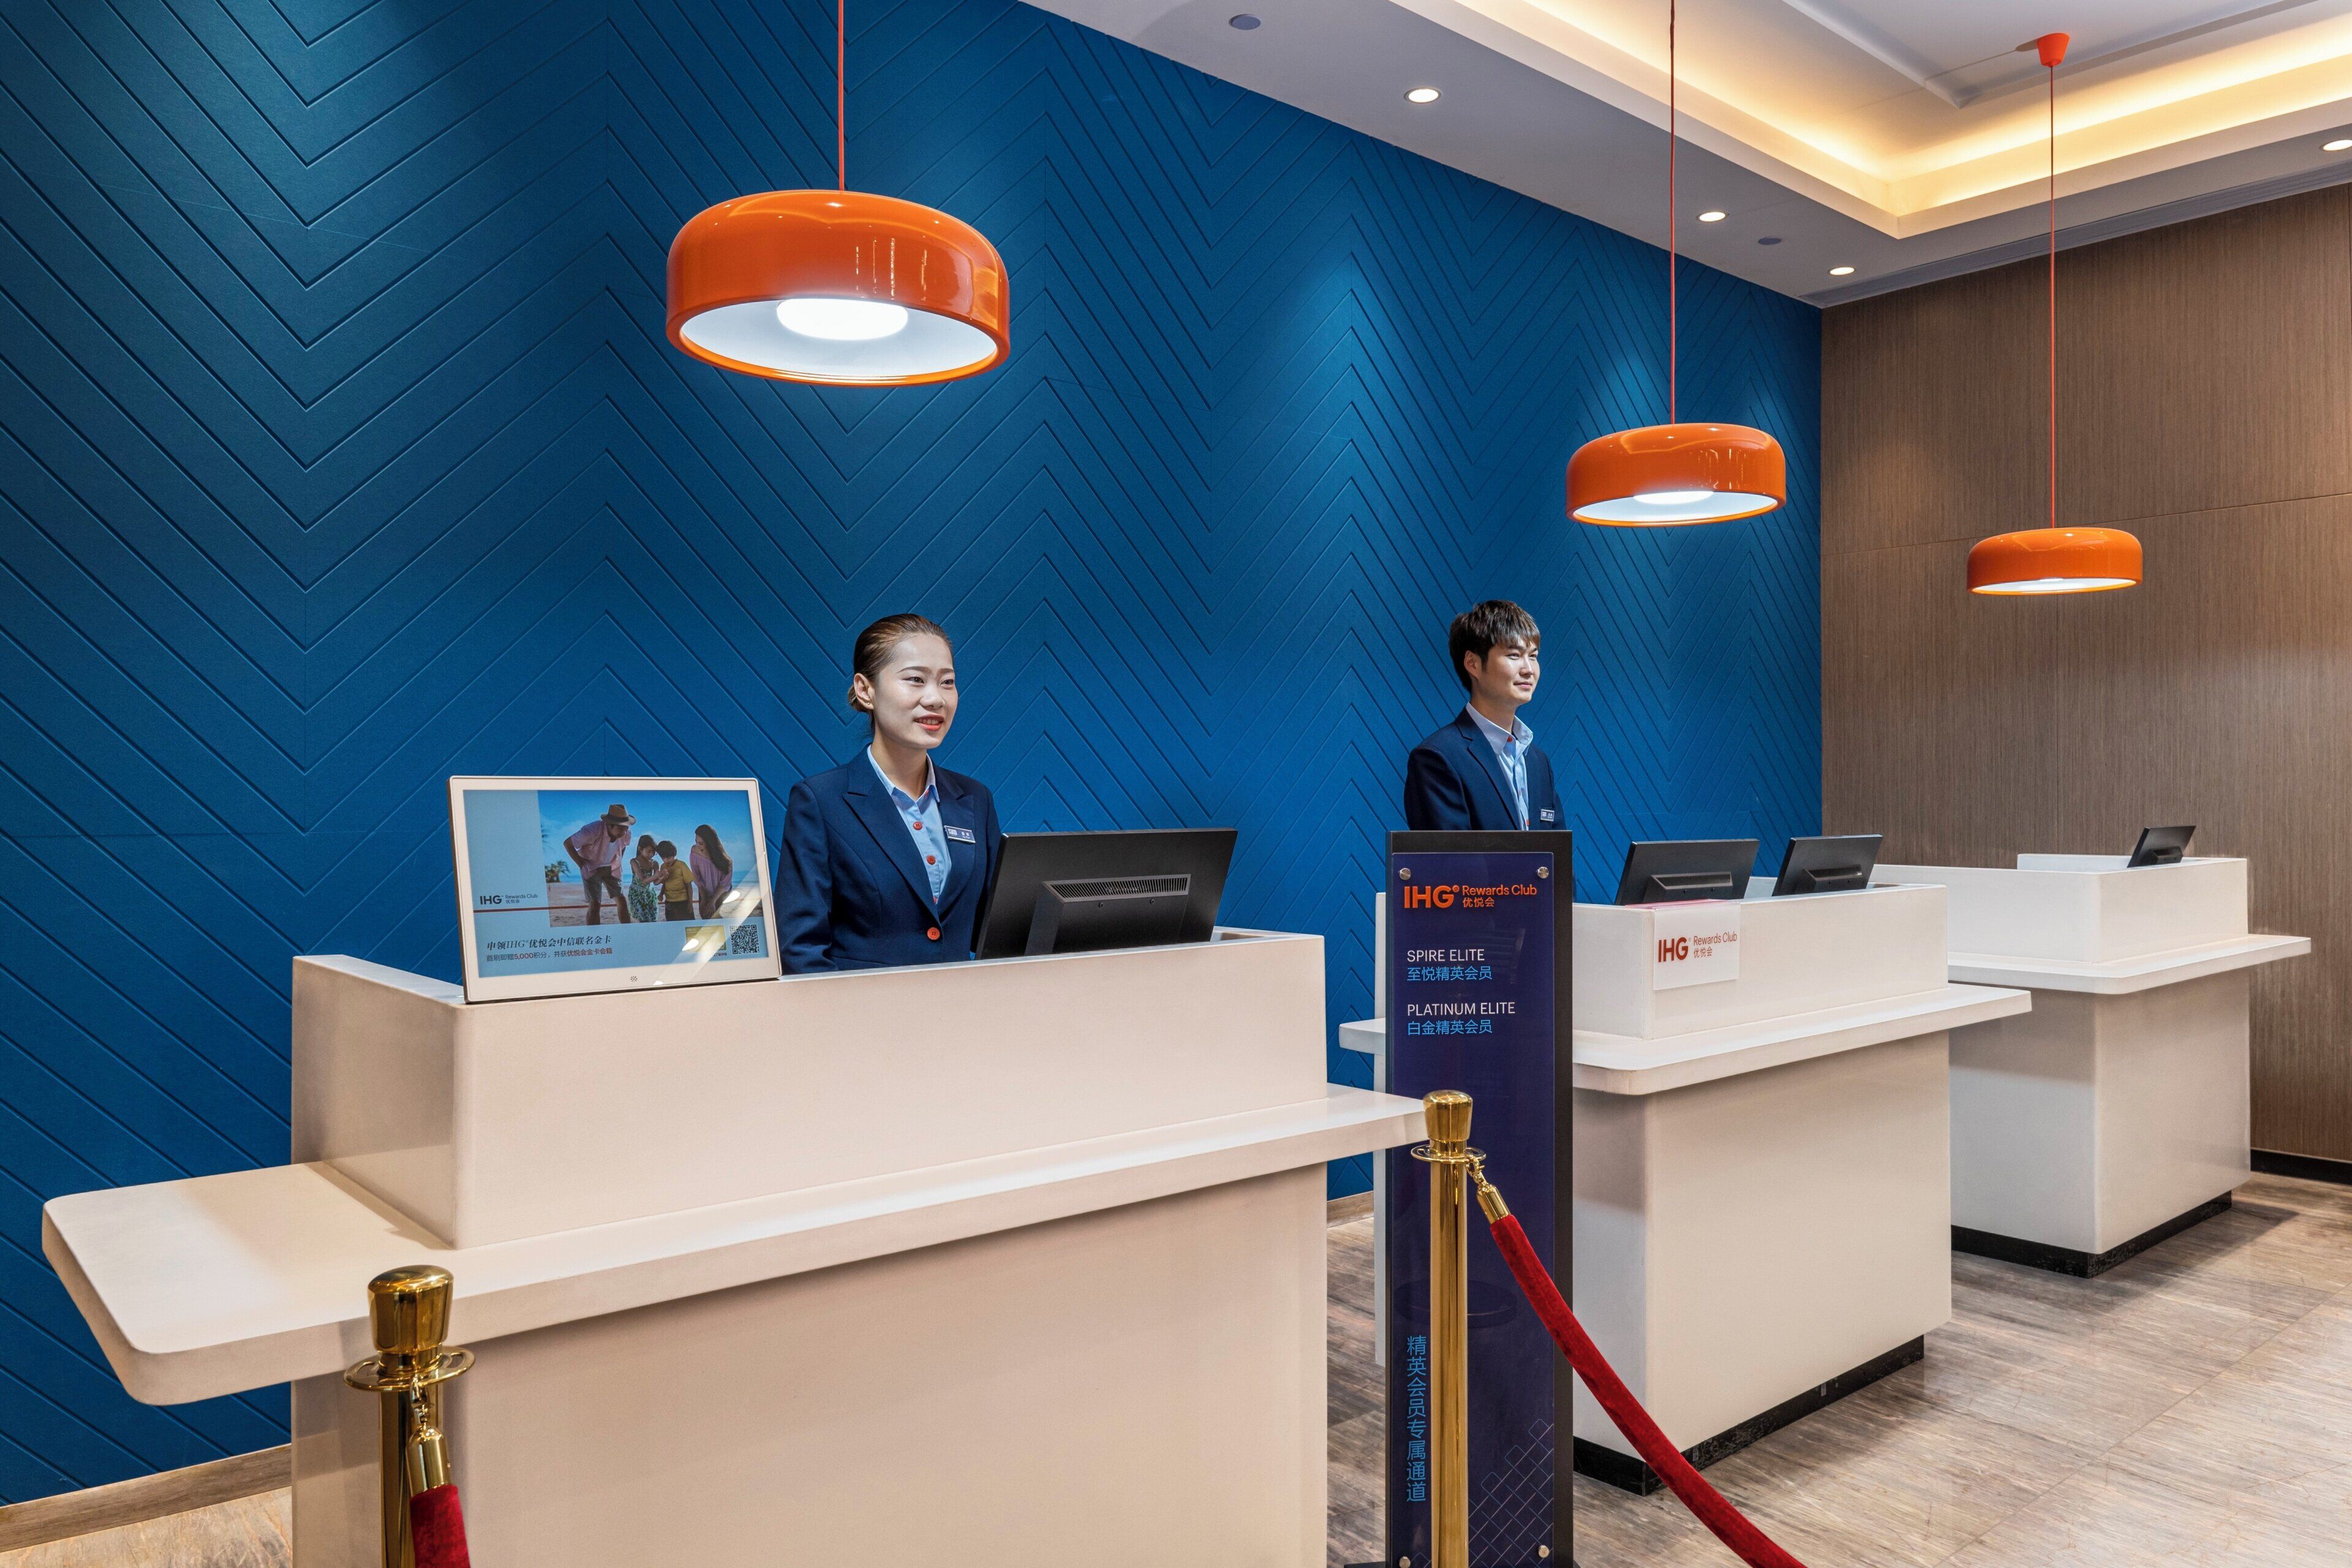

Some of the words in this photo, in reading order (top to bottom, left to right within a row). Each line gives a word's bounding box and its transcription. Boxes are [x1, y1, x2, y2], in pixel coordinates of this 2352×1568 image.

[1462, 884, 1509, 896] Rewards
[1511, 884, 1538, 895] Club
[1462, 897, 1495, 908] 优悦会
[1693, 933, 1722, 946] Rewards
[1722, 931, 1738, 943] Club
[1407, 950, 1446, 962] SPIRE
[1449, 949, 1485, 962] ELITE
[1693, 946, 1713, 959] 优悦会
[1406, 965, 1493, 982] 至悦精英会员
[1408, 1003, 1476, 1017] PLATINUM
[1480, 1001, 1516, 1014] ELITE
[1407, 1019, 1493, 1036] 白金精英会员
[1406, 1335, 1427, 1502] 精英会员专属通道
